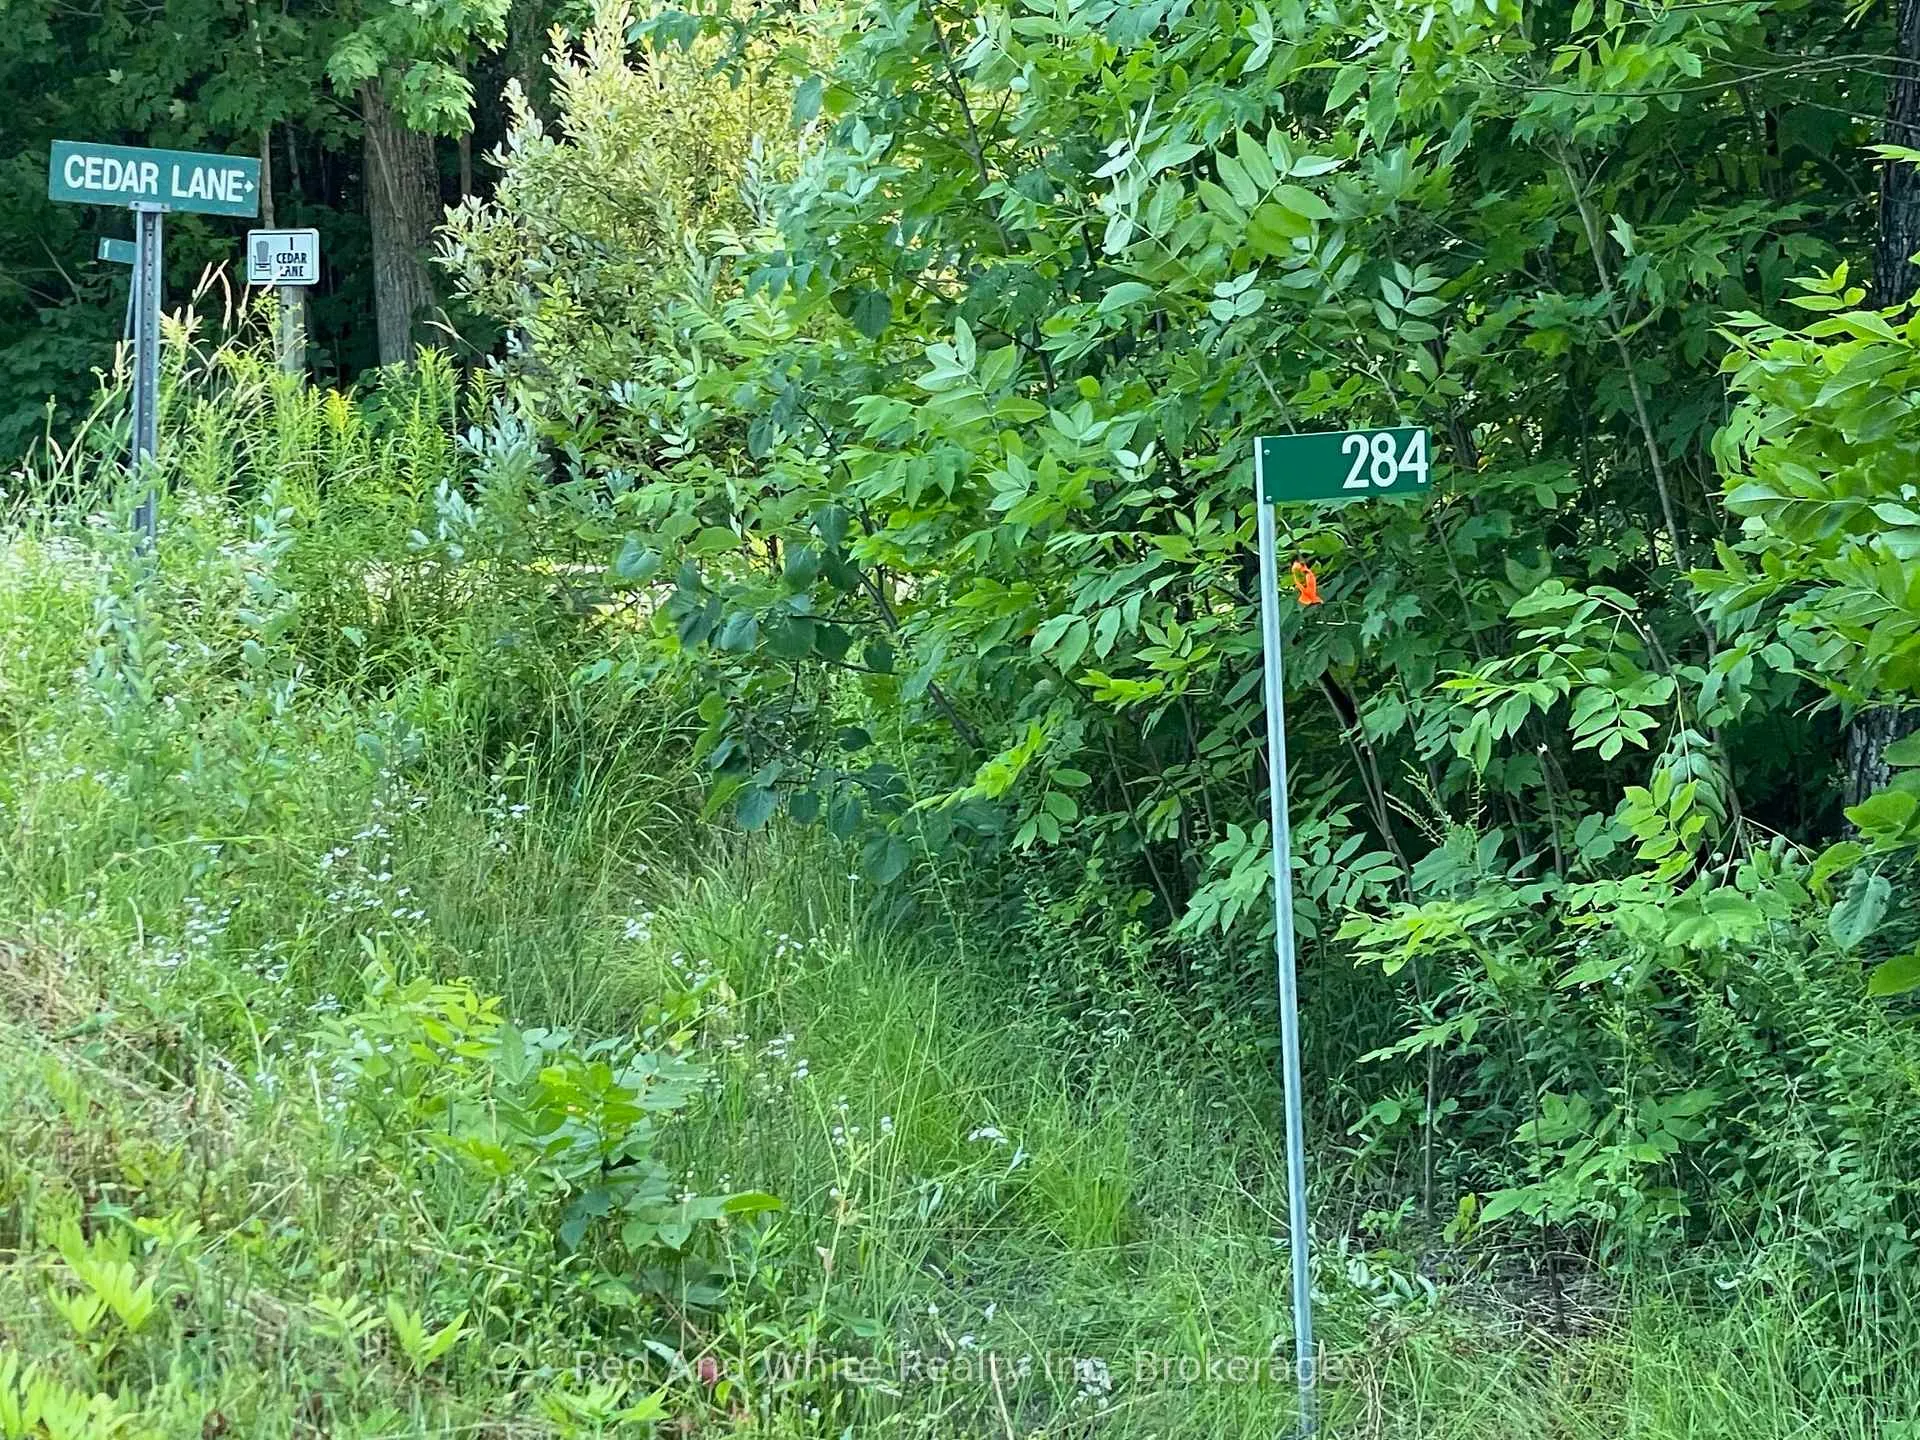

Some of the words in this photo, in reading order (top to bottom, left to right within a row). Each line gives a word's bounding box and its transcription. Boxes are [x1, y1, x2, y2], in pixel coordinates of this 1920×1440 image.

[64, 154, 159, 195] CEDAR
[171, 164, 245, 201] LANE
[103, 239, 110, 258] 1
[276, 252, 308, 264] CEDAR
[1341, 429, 1429, 489] 284
